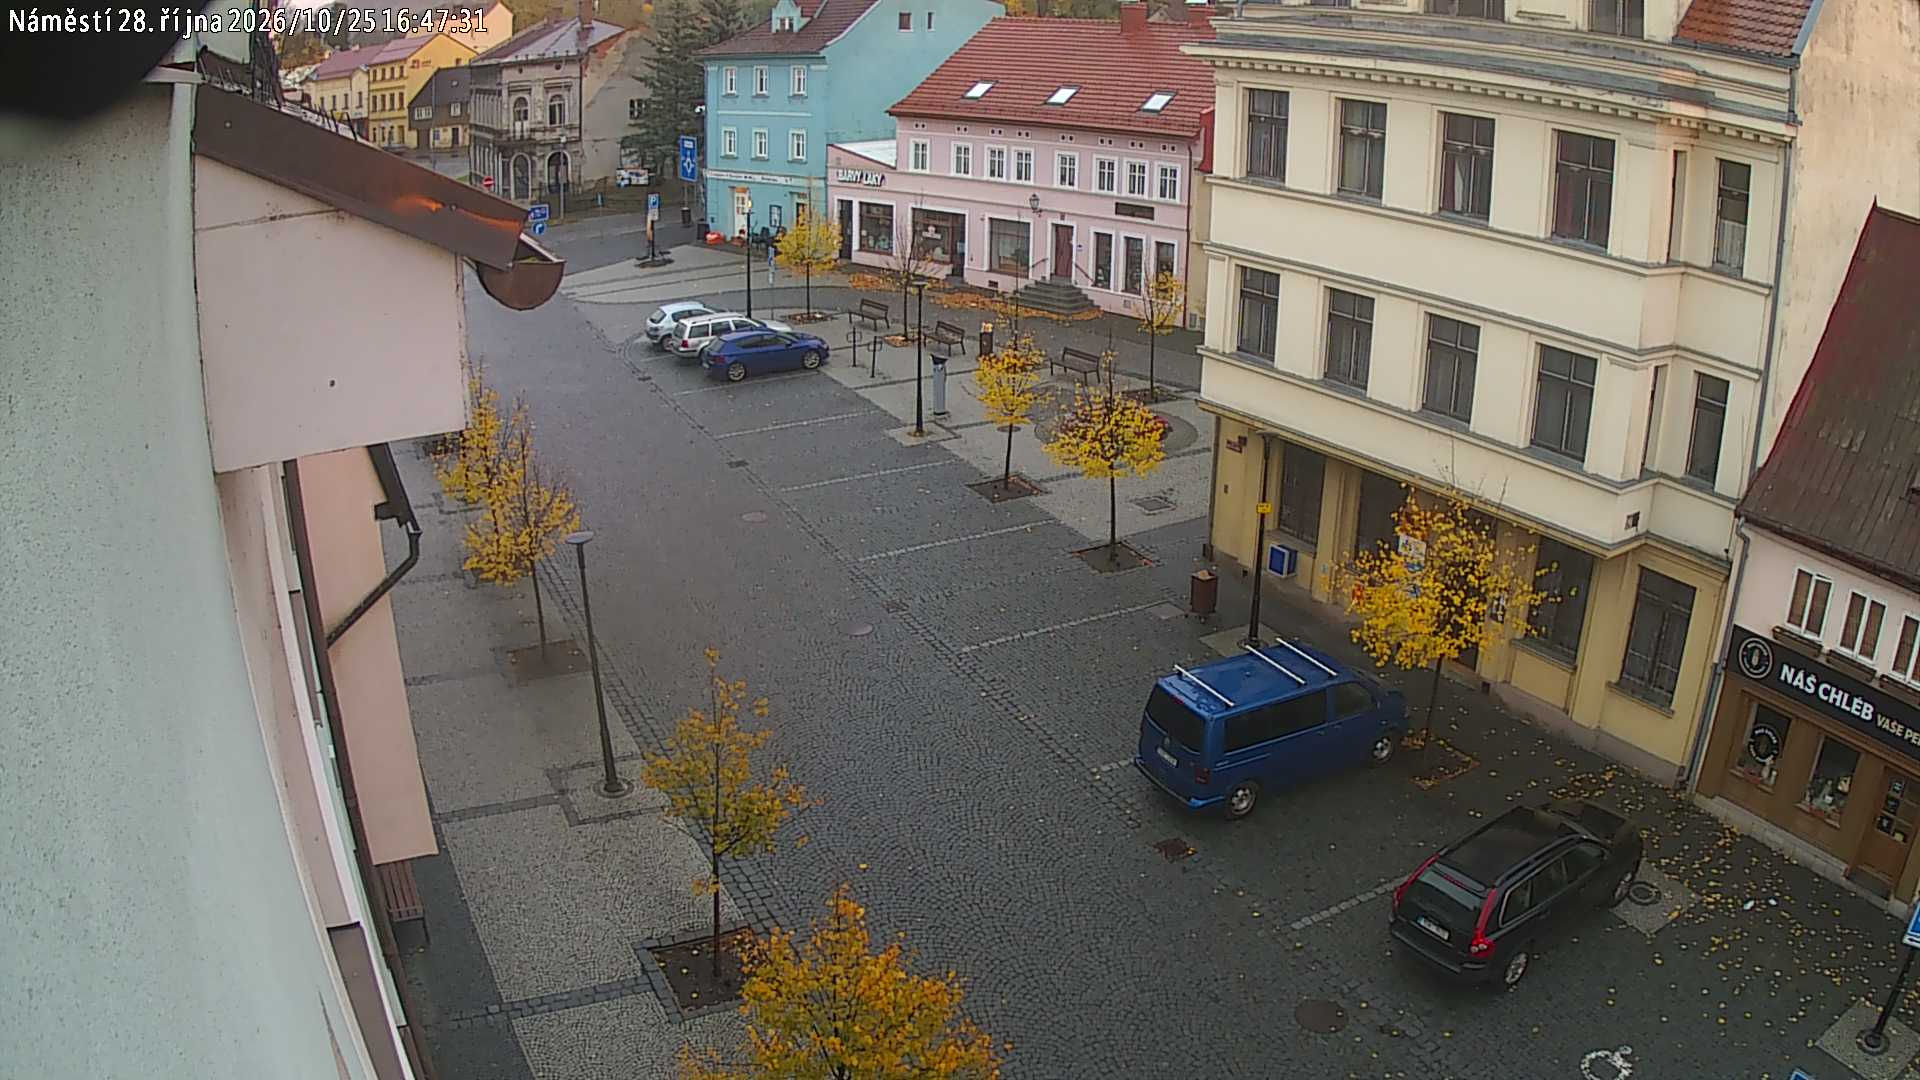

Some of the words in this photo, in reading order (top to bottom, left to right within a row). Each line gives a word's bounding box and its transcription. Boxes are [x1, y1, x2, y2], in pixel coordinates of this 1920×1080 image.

[1780, 663, 1817, 694] NÁŠ
[1818, 682, 1874, 721] CHLÉB
[1877, 713, 1905, 737] VAŠE
[1904, 727, 1920, 747] PE
